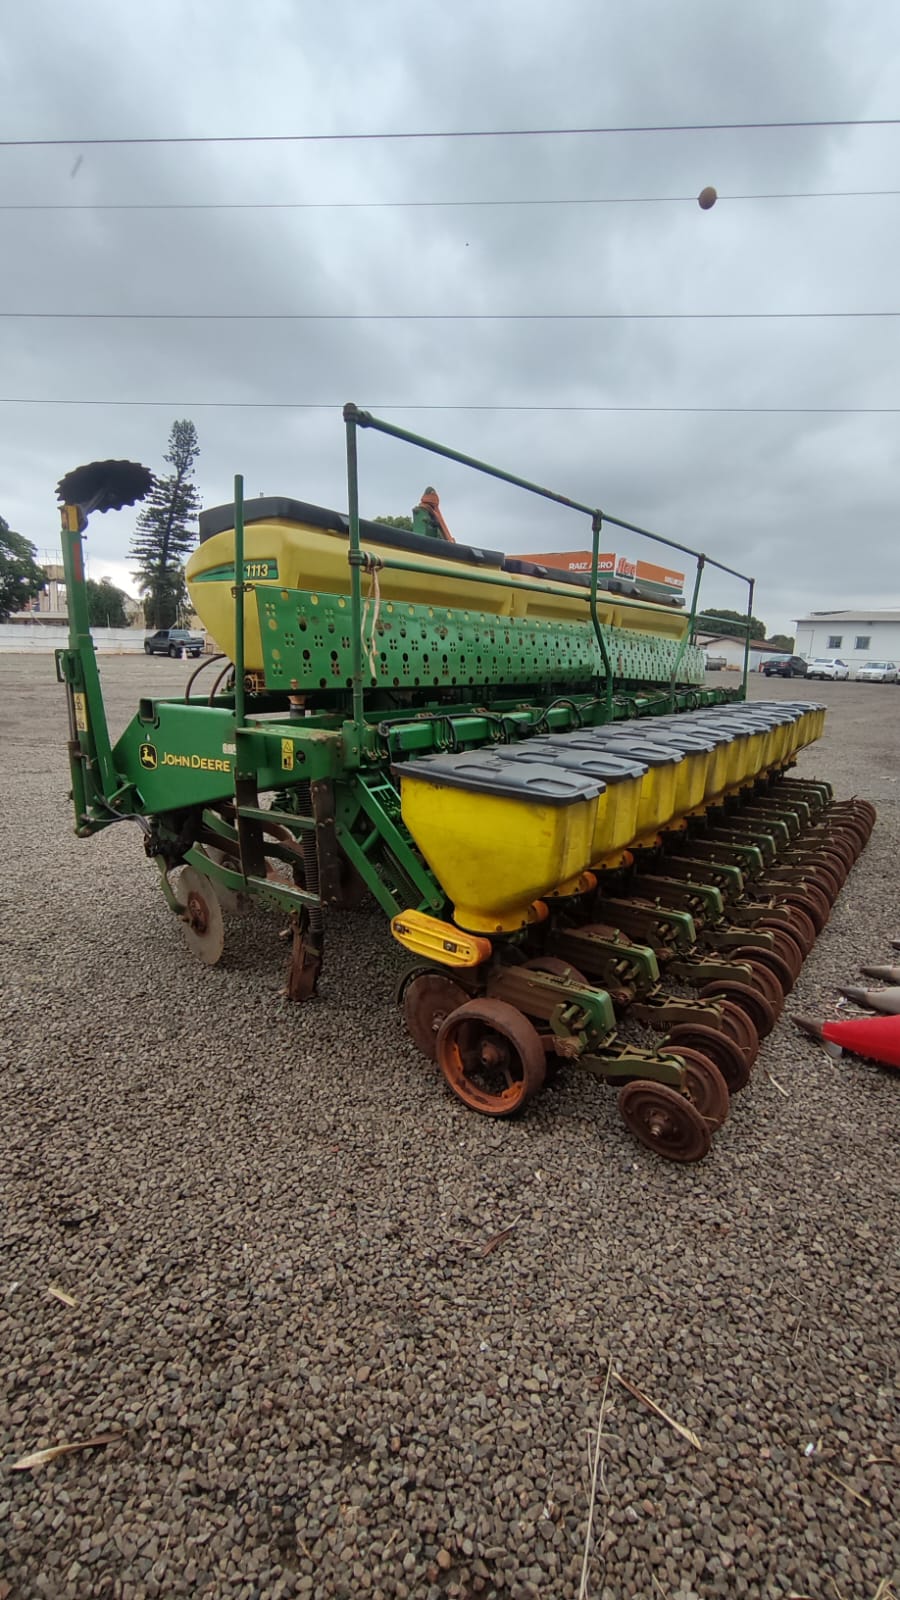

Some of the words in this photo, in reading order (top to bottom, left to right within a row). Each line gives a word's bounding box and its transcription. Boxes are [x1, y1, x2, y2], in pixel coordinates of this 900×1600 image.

[246, 564, 268, 577] 1113
[161, 752, 190, 767] JOHN
[191, 755, 231, 772] DEERE
